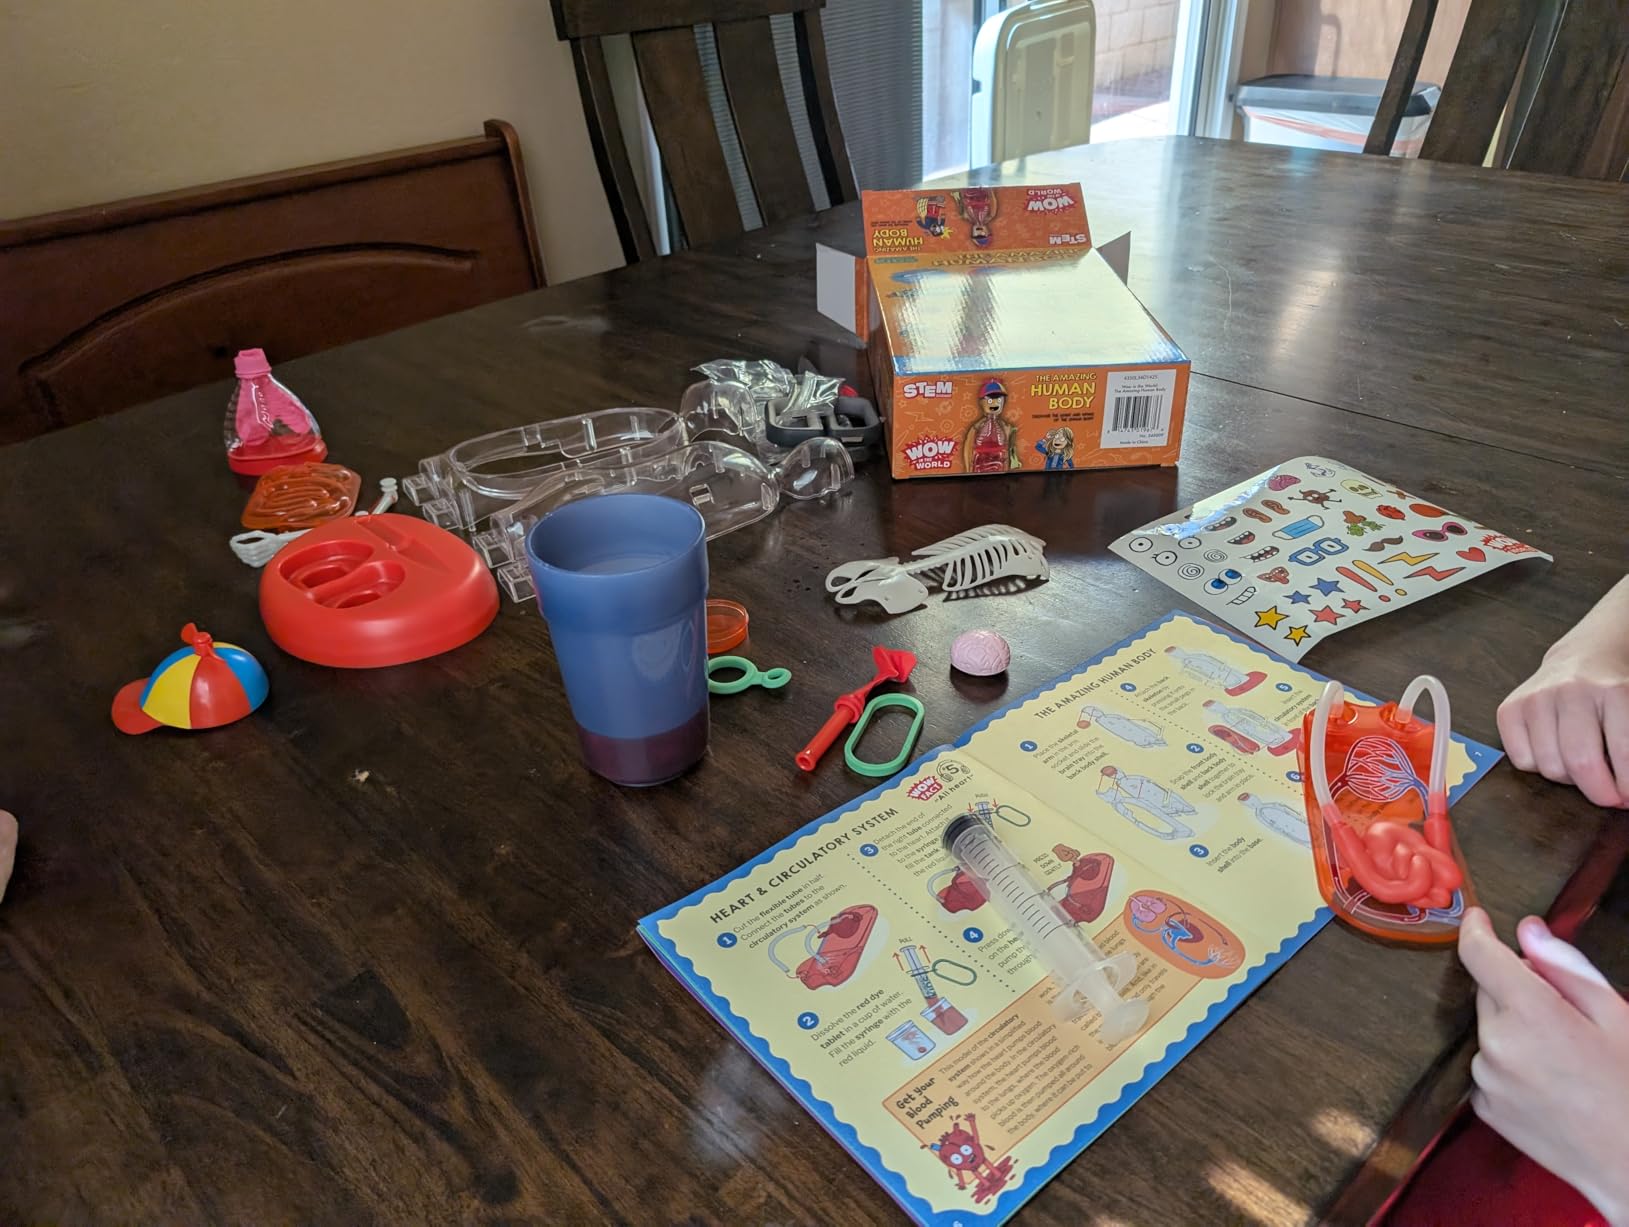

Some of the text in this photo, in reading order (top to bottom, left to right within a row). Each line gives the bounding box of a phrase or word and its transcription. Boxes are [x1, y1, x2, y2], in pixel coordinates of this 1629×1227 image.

[1028, 188, 1062, 196] WORLD
[1027, 196, 1074, 211] WOW
[873, 228, 908, 238] BODY
[1049, 234, 1087, 244] STEM
[873, 237, 923, 246] HUMAN
[1036, 372, 1096, 382] THE AMAZING
[903, 381, 953, 398] STEM
[1031, 382, 1096, 396] HUMAN
[1049, 396, 1094, 410] BODY
[906, 441, 954, 460] WOW
[916, 461, 950, 469] WORLD
[1034, 648, 1156, 720] THE AMAZING HUMAN BODY
[910, 776, 942, 800] WOW FACT
[864, 846, 874, 854] 3
[1194, 848, 1205, 856] 3
[710, 808, 898, 923] HEART & CIRCULATORY SYSTEM
[733, 923, 748, 933] Cut
[746, 916, 760, 925] the
[760, 899, 786, 917] flexible
[786, 888, 803, 900] tube
[740, 920, 772, 940] Connect
[770, 913, 784, 922] the
[784, 899, 805, 913] tubes
[812, 886, 824, 894] the
[749, 922, 788, 948] circulatory
[788, 904, 814, 923] system
[722, 936, 734, 944] 1
[969, 930, 978, 939] 4
[988, 952, 999, 960] on
[996, 944, 1010, 953] the
[802, 1014, 815, 1026] 2
[810, 990, 884, 1041] Dissolve the red dye
[820, 1031, 845, 1049] tablet
[858, 1012, 872, 1023] cup
[872, 1004, 880, 1013] of
[828, 999, 912, 1058] Fill the syringe with the
[839, 1054, 854, 1067] red
[896, 1077, 935, 1110] Get your
[906, 1096, 934, 1119] Blood
[916, 1096, 959, 1130] Pumping
